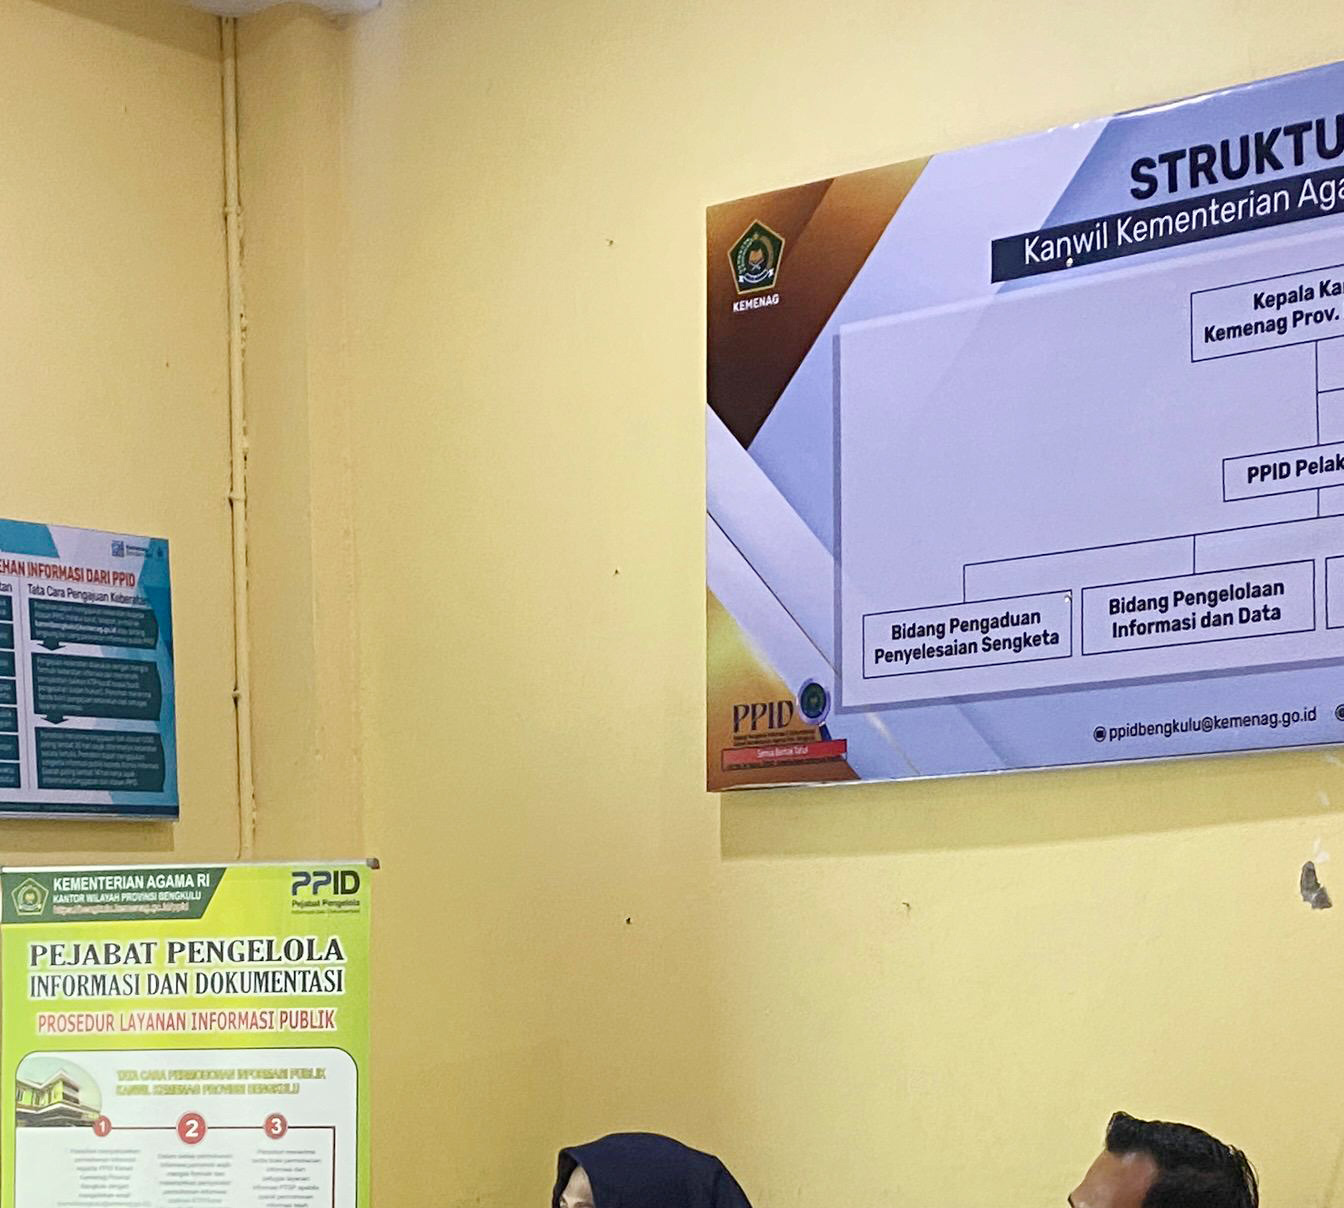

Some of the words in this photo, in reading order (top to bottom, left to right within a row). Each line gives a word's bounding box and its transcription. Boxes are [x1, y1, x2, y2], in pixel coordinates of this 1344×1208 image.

[1023, 222, 1110, 266] Kanwil
[1115, 188, 1291, 247] Kementerian
[733, 293, 780, 313] KEMENAG
[1252, 283, 1315, 312] Kepala
[1203, 316, 1289, 346] Kemenag
[1291, 306, 1340, 332] Prov.
[1246, 459, 1291, 485] PPID
[27, 562, 85, 583] INFORMASI
[86, 569, 111, 586] DARI
[112, 571, 136, 587] PPID
[28, 583, 45, 595] Tata
[46, 585, 66, 598] Cara
[66, 588, 110, 603] Pengajuan
[1107, 591, 1169, 620] Bidang
[1172, 578, 1286, 612] Pengelolaan
[891, 615, 945, 645] Bidang
[947, 606, 1042, 639] Pengaduan
[1111, 613, 1197, 640] Informasi
[1199, 608, 1235, 631] dan
[1238, 602, 1282, 626] Data
[873, 633, 978, 669] Penyelesaian
[980, 627, 1060, 656] Sengketa
[733, 700, 795, 733] PPID
[1108, 706, 1318, 744] ppidbengkulu@kemenag.go.id
[53, 875, 145, 891] KEMENTERIAN
[147, 873, 195, 889] AGAMA
[197, 872, 210, 888] RI
[291, 870, 361, 896] PPID
[30, 942, 158, 967] PEJABAT
[167, 938, 345, 964] PENGELOLA
[30, 972, 140, 998] INFORMASI
[146, 971, 189, 996] DAN
[195, 969, 343, 995] DOKUMENTASI
[38, 1013, 115, 1034] PROSEDUR
[120, 1011, 186, 1033] LAYANAN
[191, 1010, 275, 1031] INFORMASI
[280, 1009, 336, 1030] PUBLIK
[98, 1120, 107, 1133] 1
[185, 1119, 199, 1138] 2
[270, 1117, 283, 1135] 3
